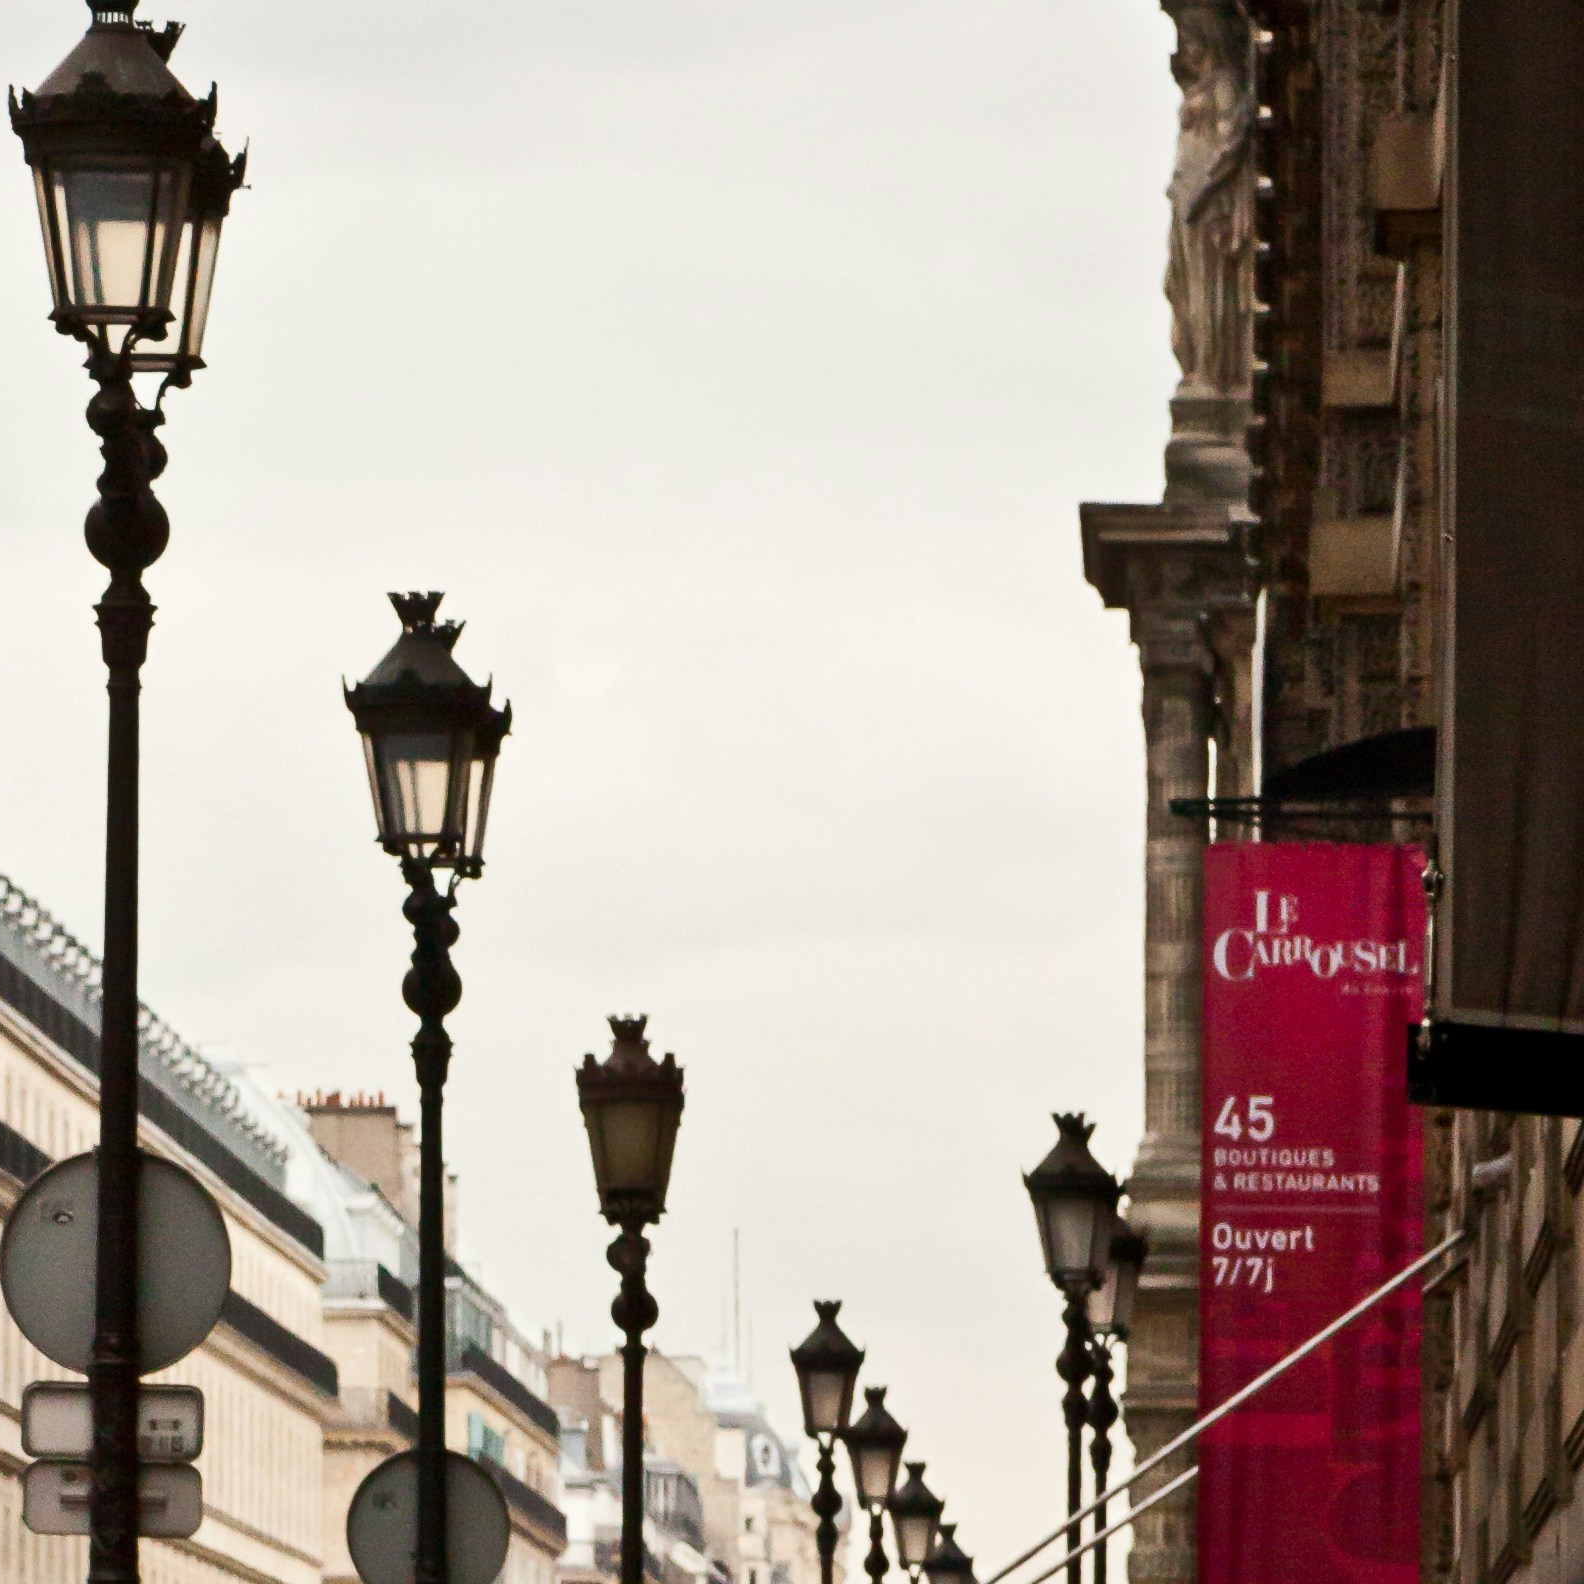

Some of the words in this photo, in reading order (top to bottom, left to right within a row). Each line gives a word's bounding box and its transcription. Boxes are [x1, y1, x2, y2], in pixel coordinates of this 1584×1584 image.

[1254, 889, 1299, 935] LE
[1213, 928, 1419, 981] CARROUSEL
[1213, 1095, 1275, 1142] 45
[1215, 1148, 1335, 1168] BOUTIQUES
[1214, 1173, 1228, 1191] &
[1233, 1173, 1380, 1194] RESTAURANTS
[1212, 1222, 1314, 1251] Ouvert
[1212, 1255, 1273, 1294] 7/7j
